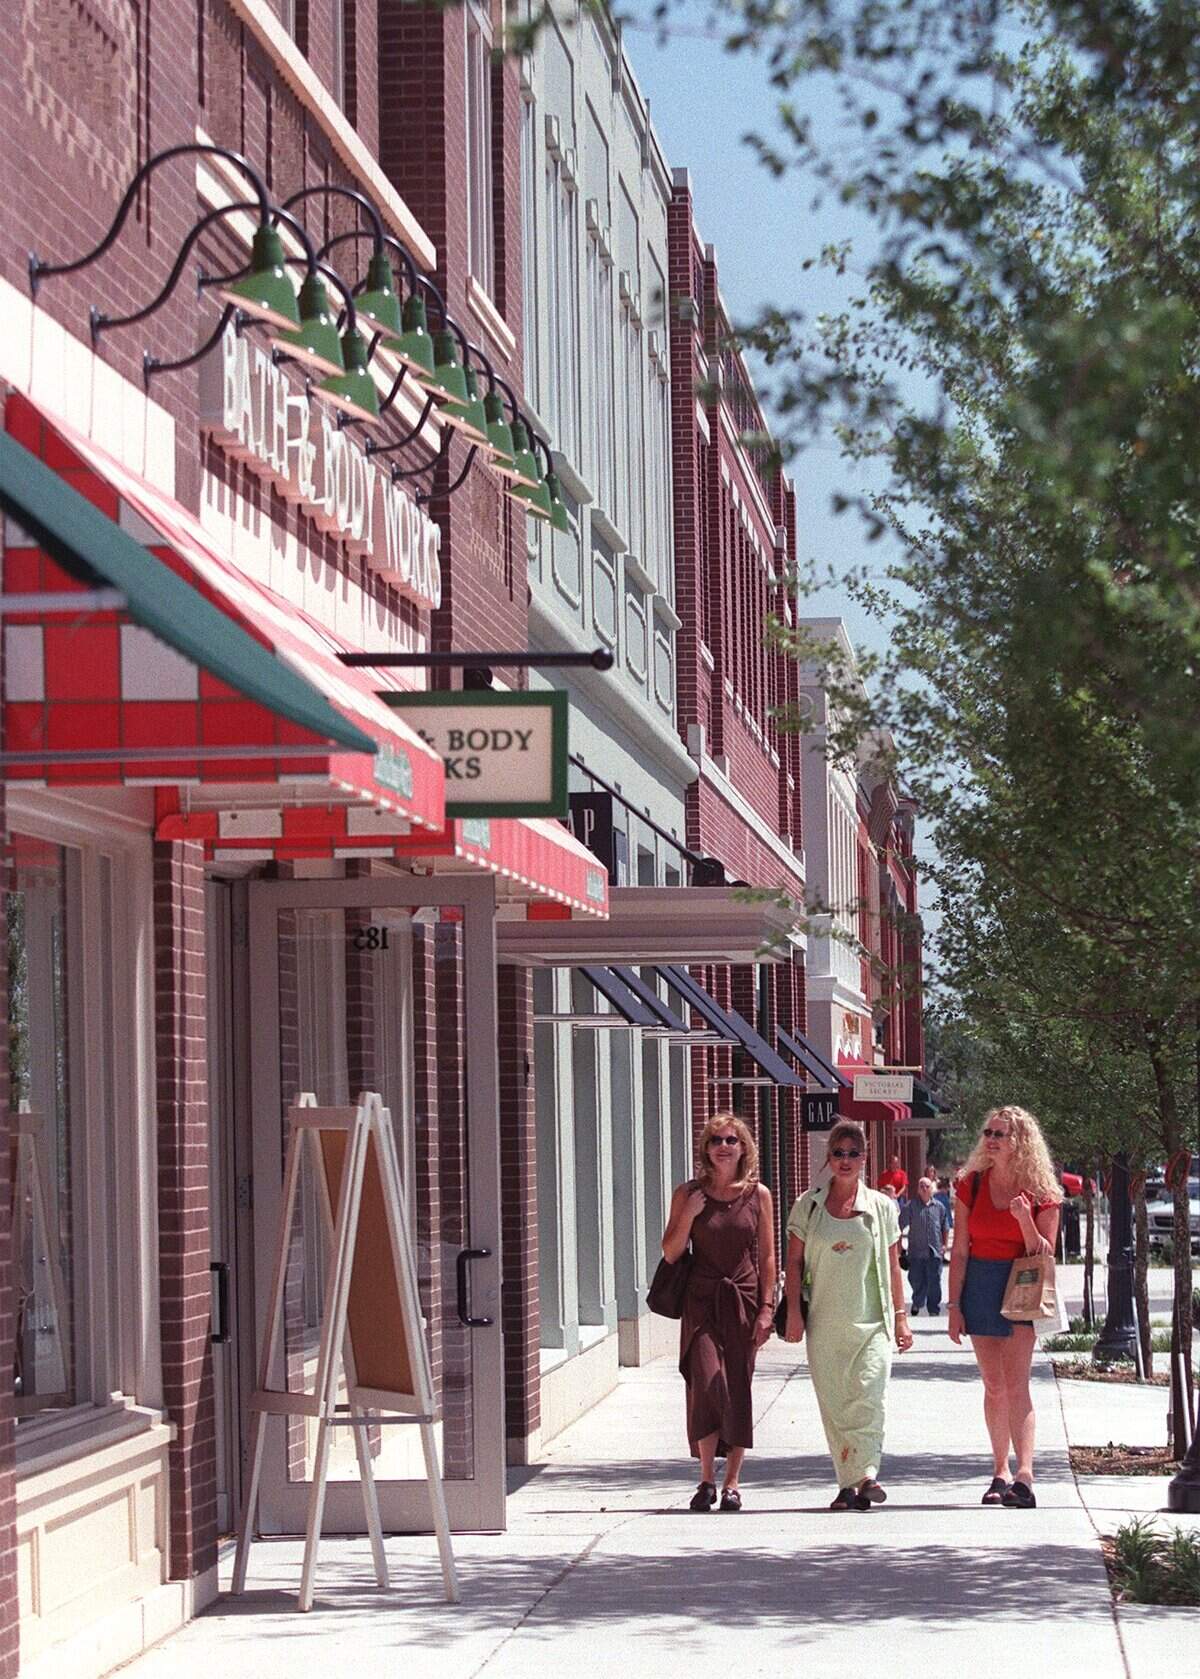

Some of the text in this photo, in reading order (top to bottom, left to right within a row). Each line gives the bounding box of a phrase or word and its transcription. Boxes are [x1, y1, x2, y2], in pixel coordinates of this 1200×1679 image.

[222, 320, 290, 481] BATH
[321, 412, 376, 556] BODY
[381, 473, 441, 610] WORKS
[447, 728, 533, 751] BODY
[808, 1101, 833, 1123] GAP
